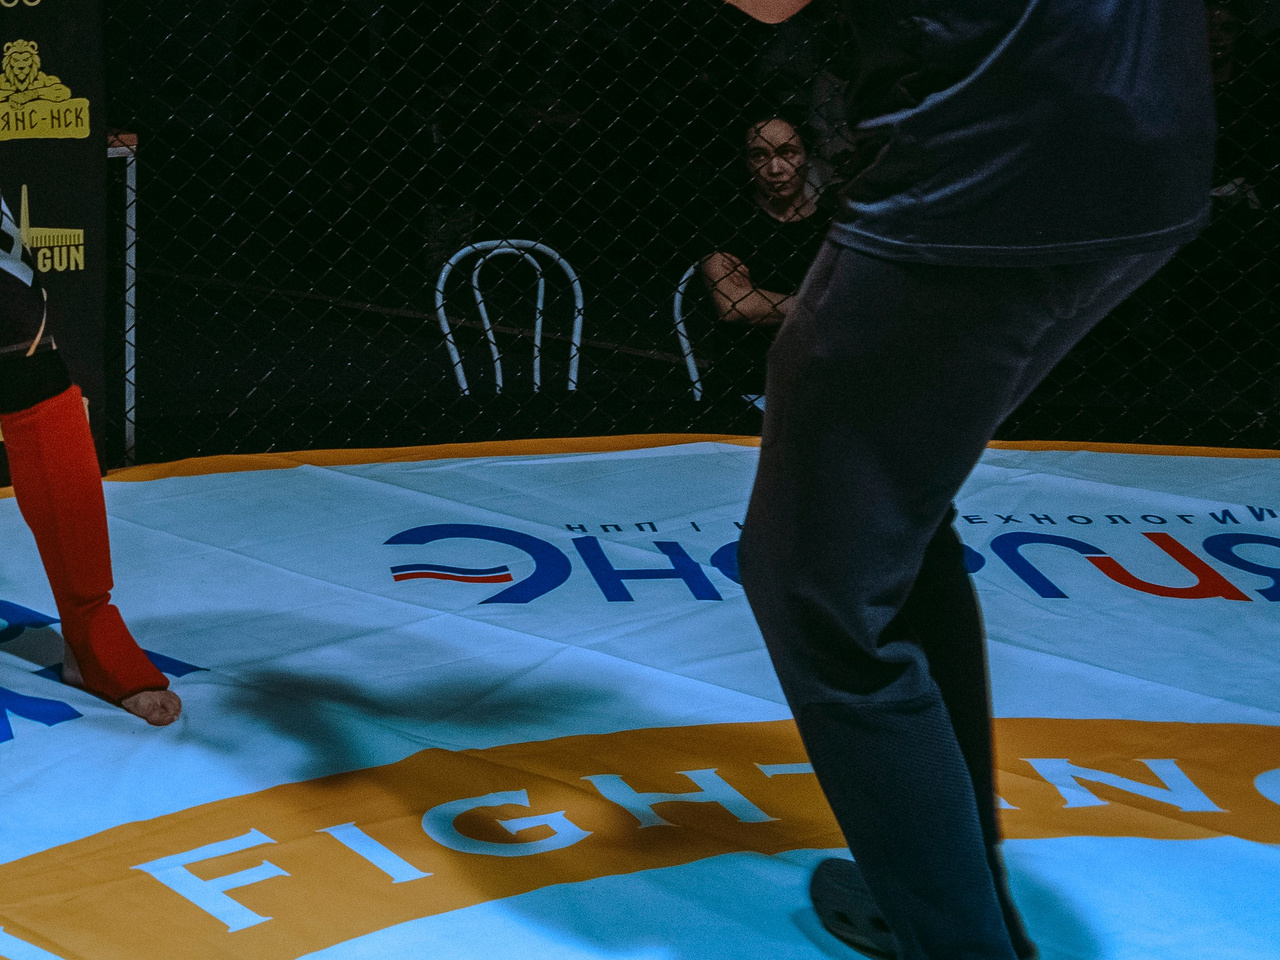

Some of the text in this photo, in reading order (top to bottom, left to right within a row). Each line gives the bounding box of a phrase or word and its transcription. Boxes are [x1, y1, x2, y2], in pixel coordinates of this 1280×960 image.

[36, 245, 85, 273] GUN
[962, 504, 1278, 526] ЕХНОЛОГИИ
[129, 757, 1280, 934] FIGHN
